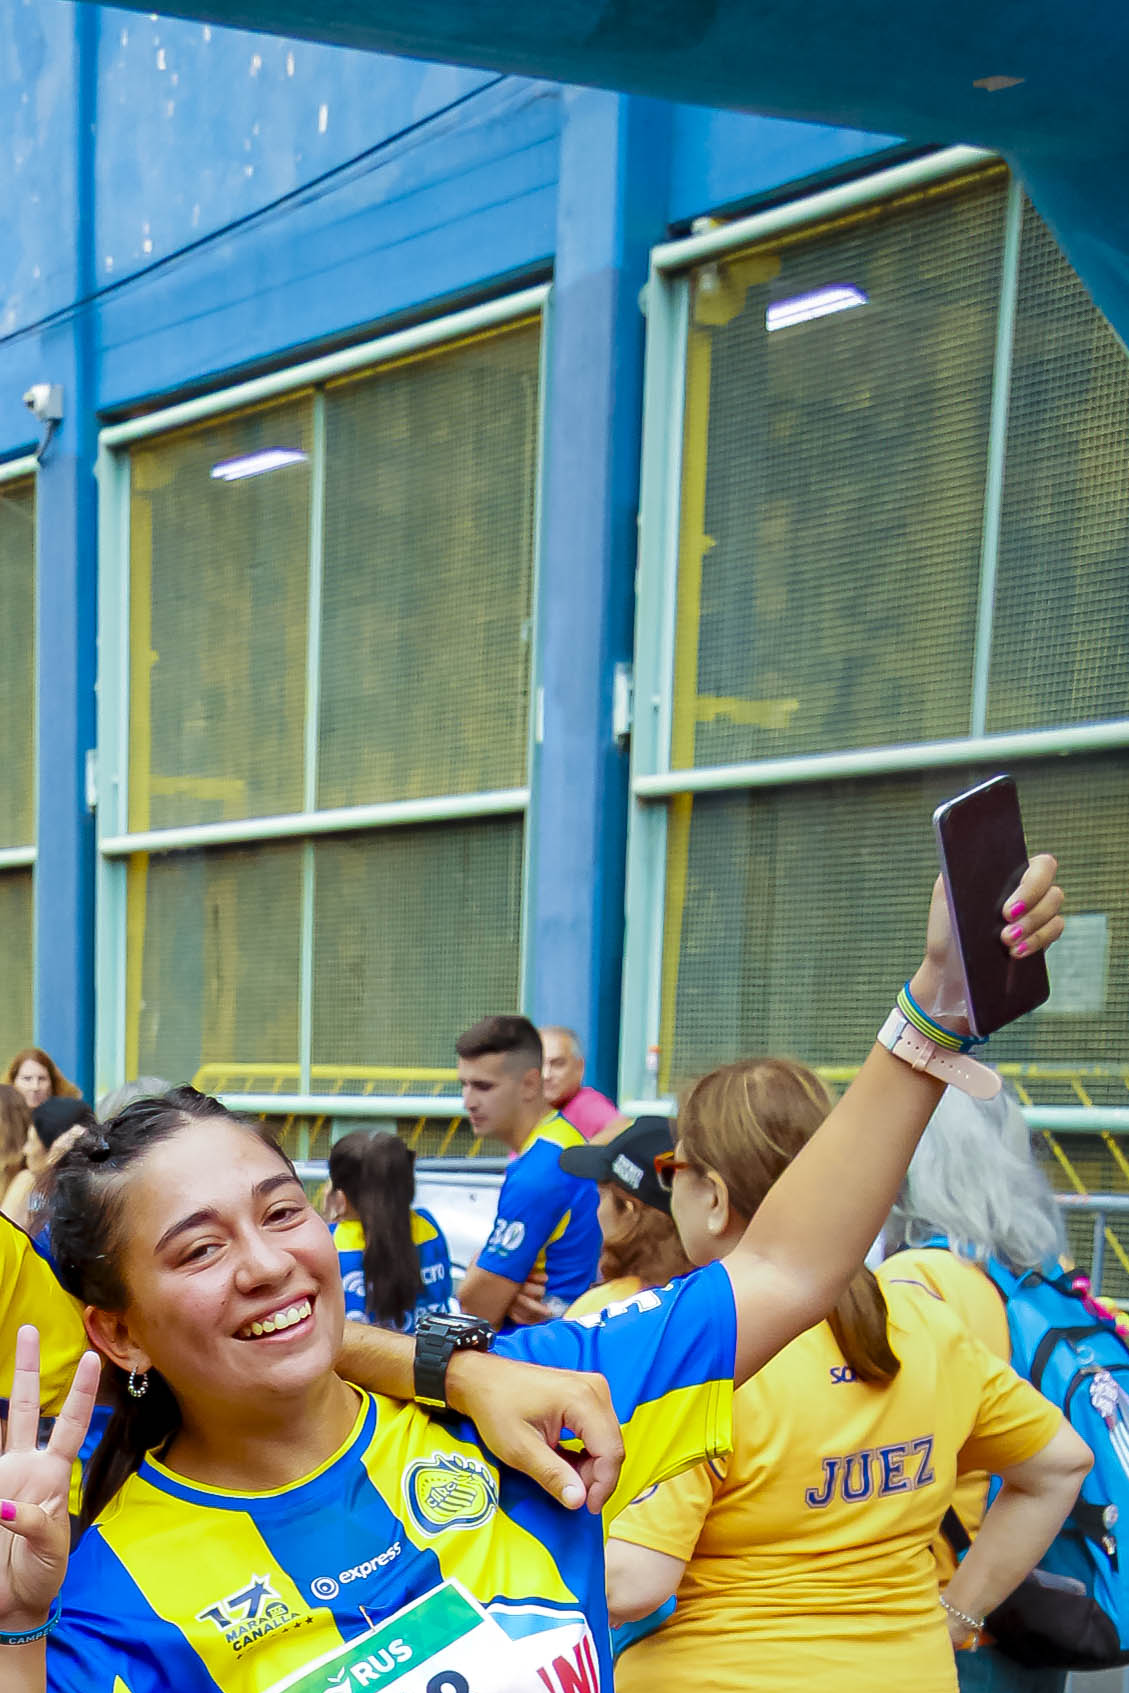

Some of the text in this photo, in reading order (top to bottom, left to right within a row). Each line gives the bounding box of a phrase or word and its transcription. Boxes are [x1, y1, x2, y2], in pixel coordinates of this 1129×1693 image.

[805, 1434, 936, 1509] JUEZ
[339, 1541, 401, 1584] express
[350, 1638, 413, 1687] RUS
